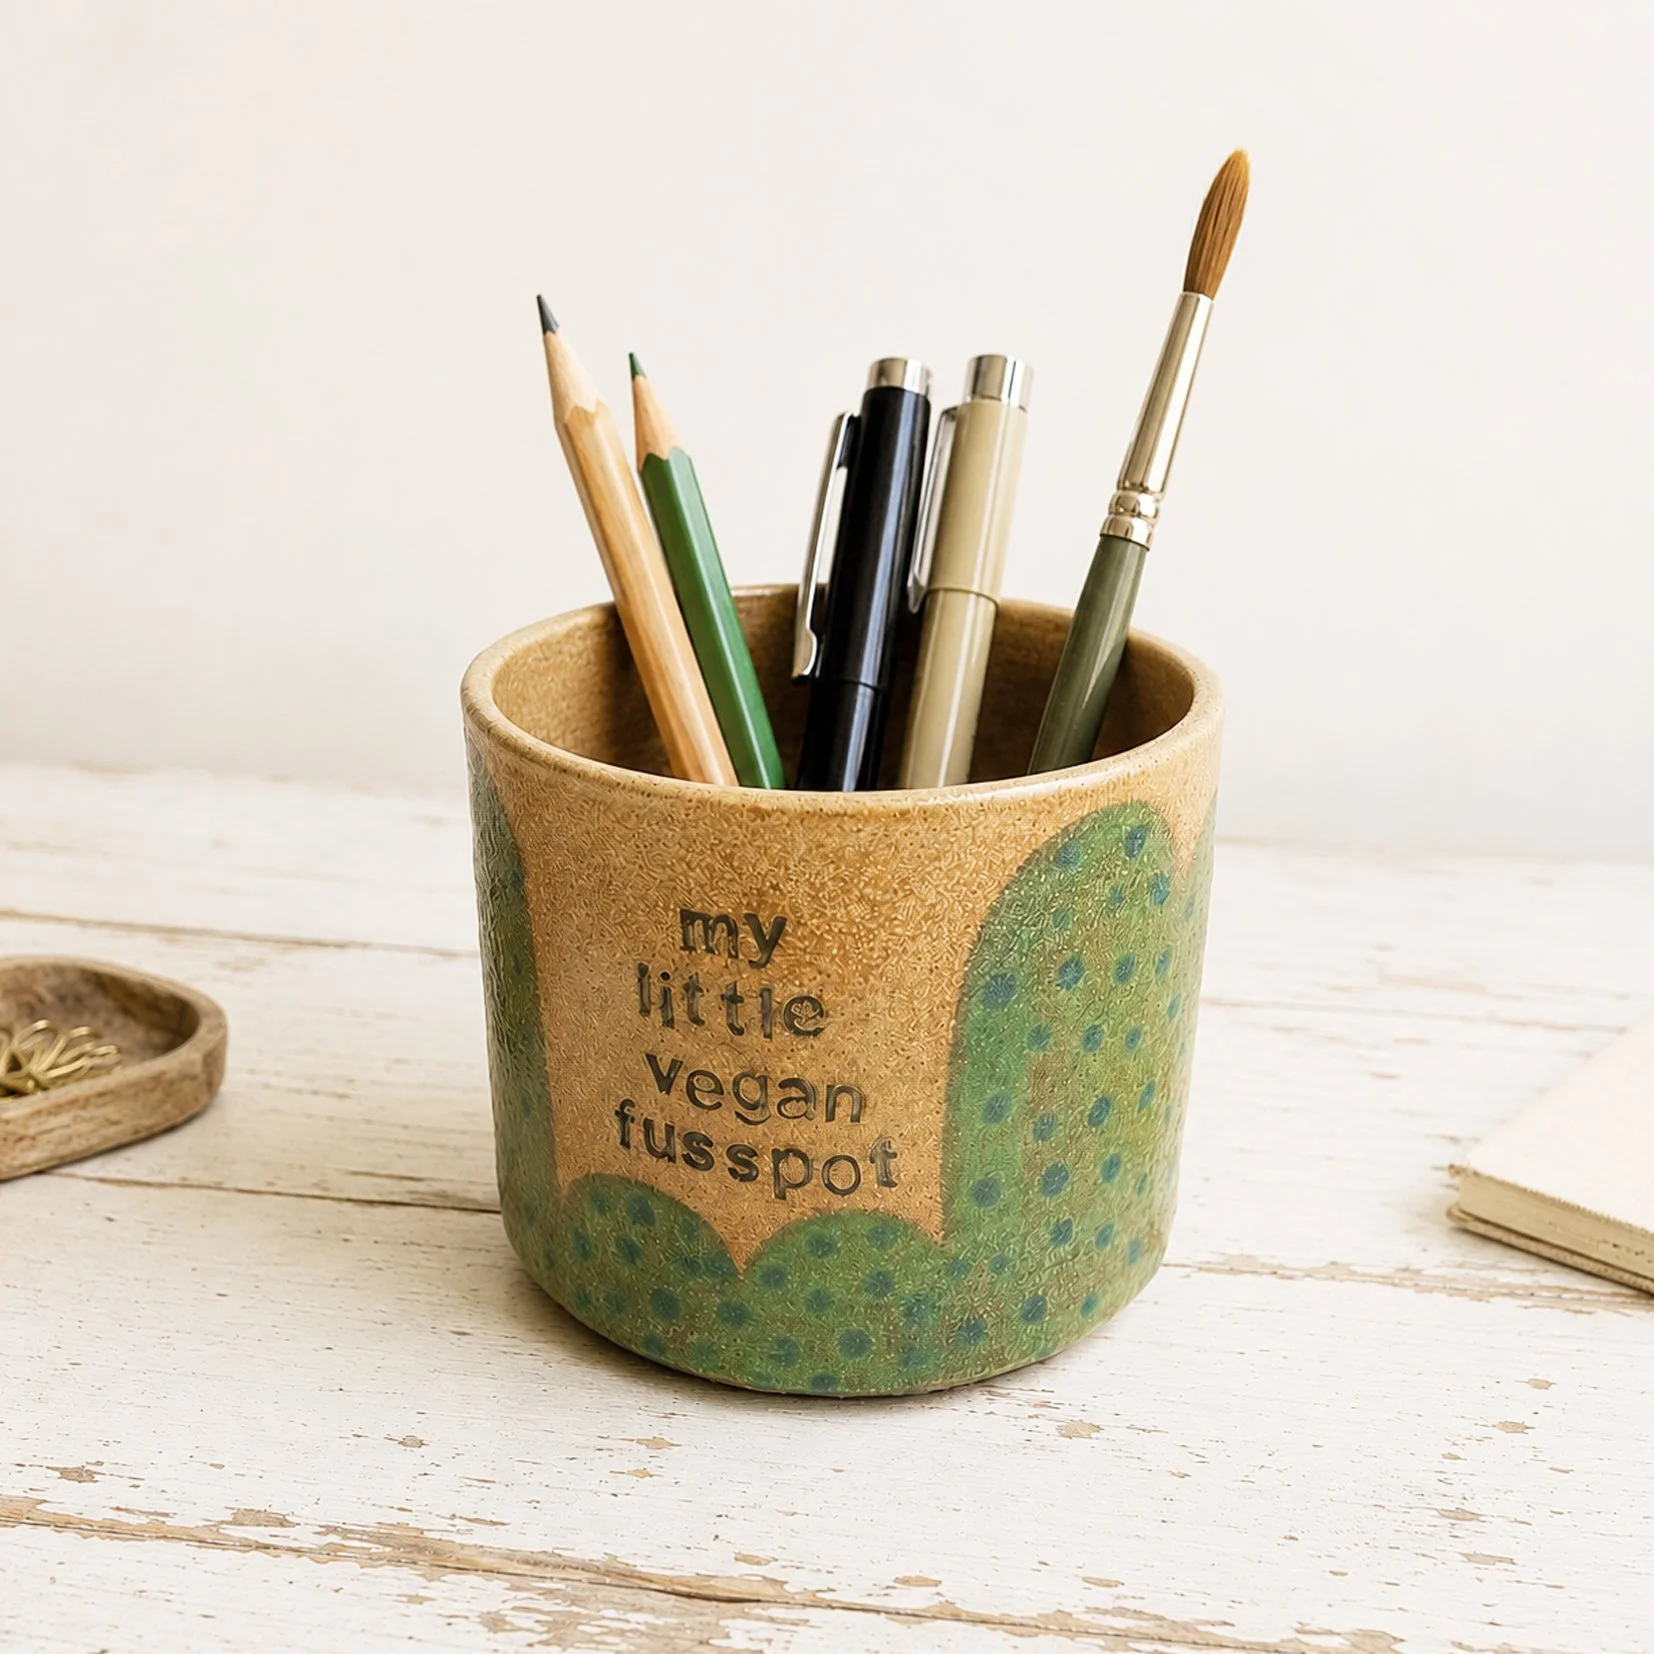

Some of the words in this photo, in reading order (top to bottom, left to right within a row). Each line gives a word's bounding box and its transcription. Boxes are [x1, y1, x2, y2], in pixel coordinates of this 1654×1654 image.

[679, 908, 787, 968] my
[637, 962, 825, 1039] little
[645, 1053, 866, 1125] vegan
[615, 1098, 898, 1200] fusspot
